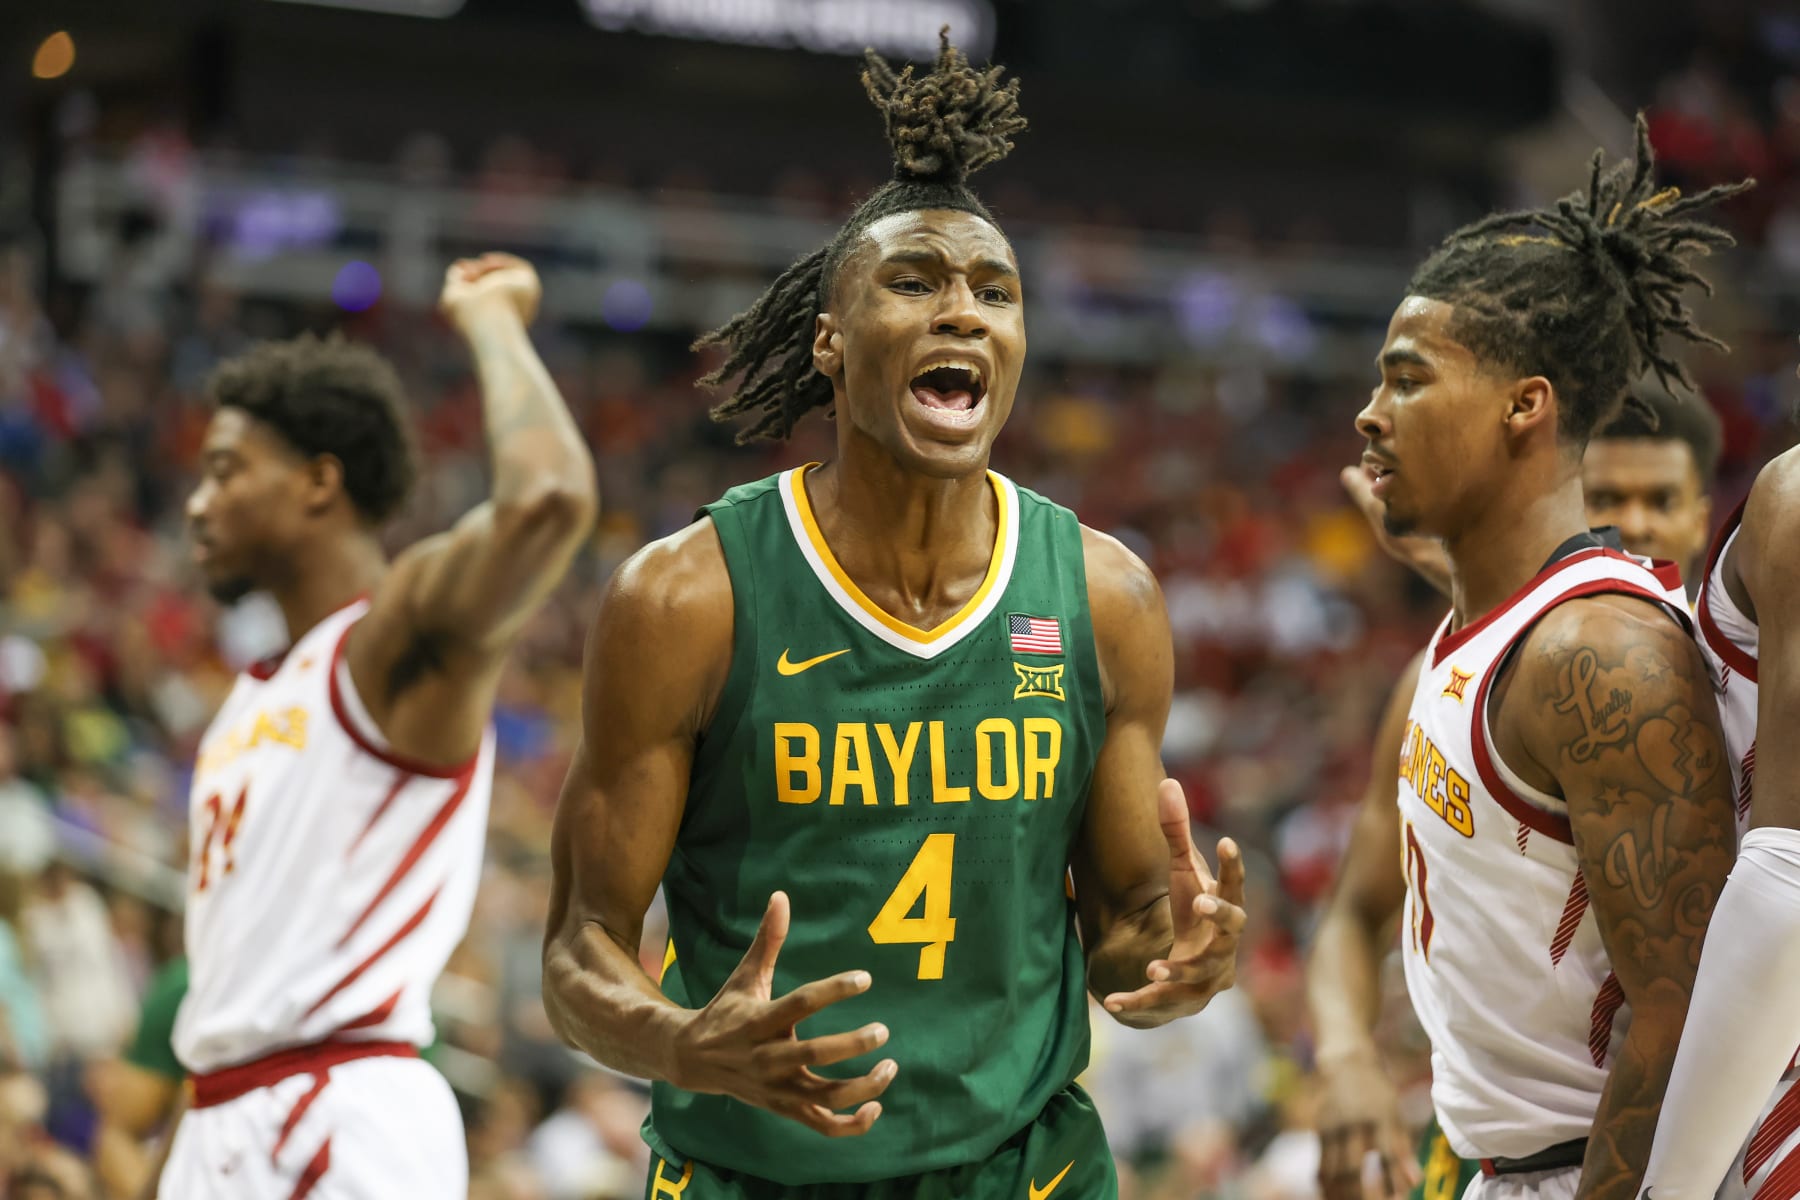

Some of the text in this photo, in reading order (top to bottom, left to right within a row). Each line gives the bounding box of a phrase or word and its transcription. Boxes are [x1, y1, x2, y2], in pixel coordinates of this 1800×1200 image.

[1014, 662, 1064, 701] XII
[774, 718, 1062, 806] BAYLOR
[867, 833, 957, 980] 4
